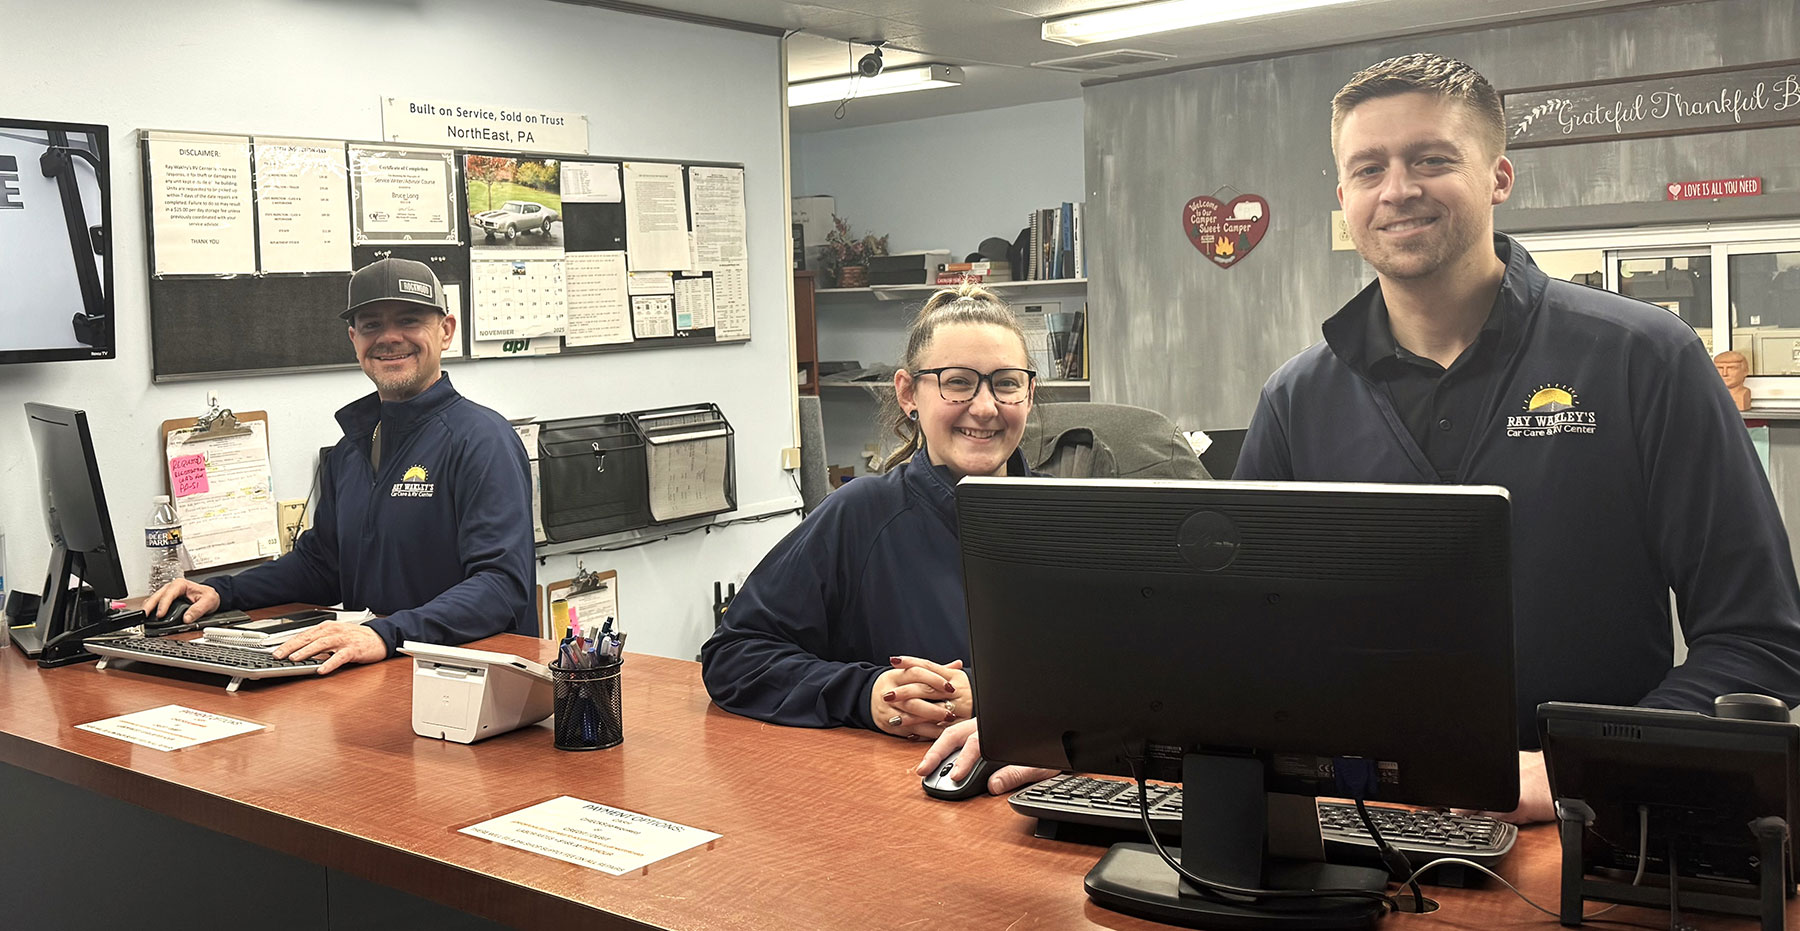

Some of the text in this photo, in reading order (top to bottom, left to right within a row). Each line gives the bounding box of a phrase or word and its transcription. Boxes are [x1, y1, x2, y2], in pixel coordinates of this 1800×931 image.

[410, 103, 564, 126] Built on Service, Sold on Trust
[1559, 94, 1648, 134] Grateful
[1650, 83, 1769, 123] Thankful
[447, 126, 534, 143] NorthEast, PA
[179, 148, 221, 157] DISCLAIMER:
[1684, 180, 1758, 197] LOVE IS ALL YOU NEED
[1189, 200, 1218, 211] Welcome
[1191, 215, 1217, 226] Camper
[1199, 223, 1252, 235] Sweet Camper
[1507, 416, 1532, 426] RAY
[1507, 429, 1522, 437] Car
[1524, 429, 1545, 437] Care
[1564, 425, 1596, 433] Center
[148, 532, 168, 540] DEER
[582, 804, 632, 818] PAYMENT
